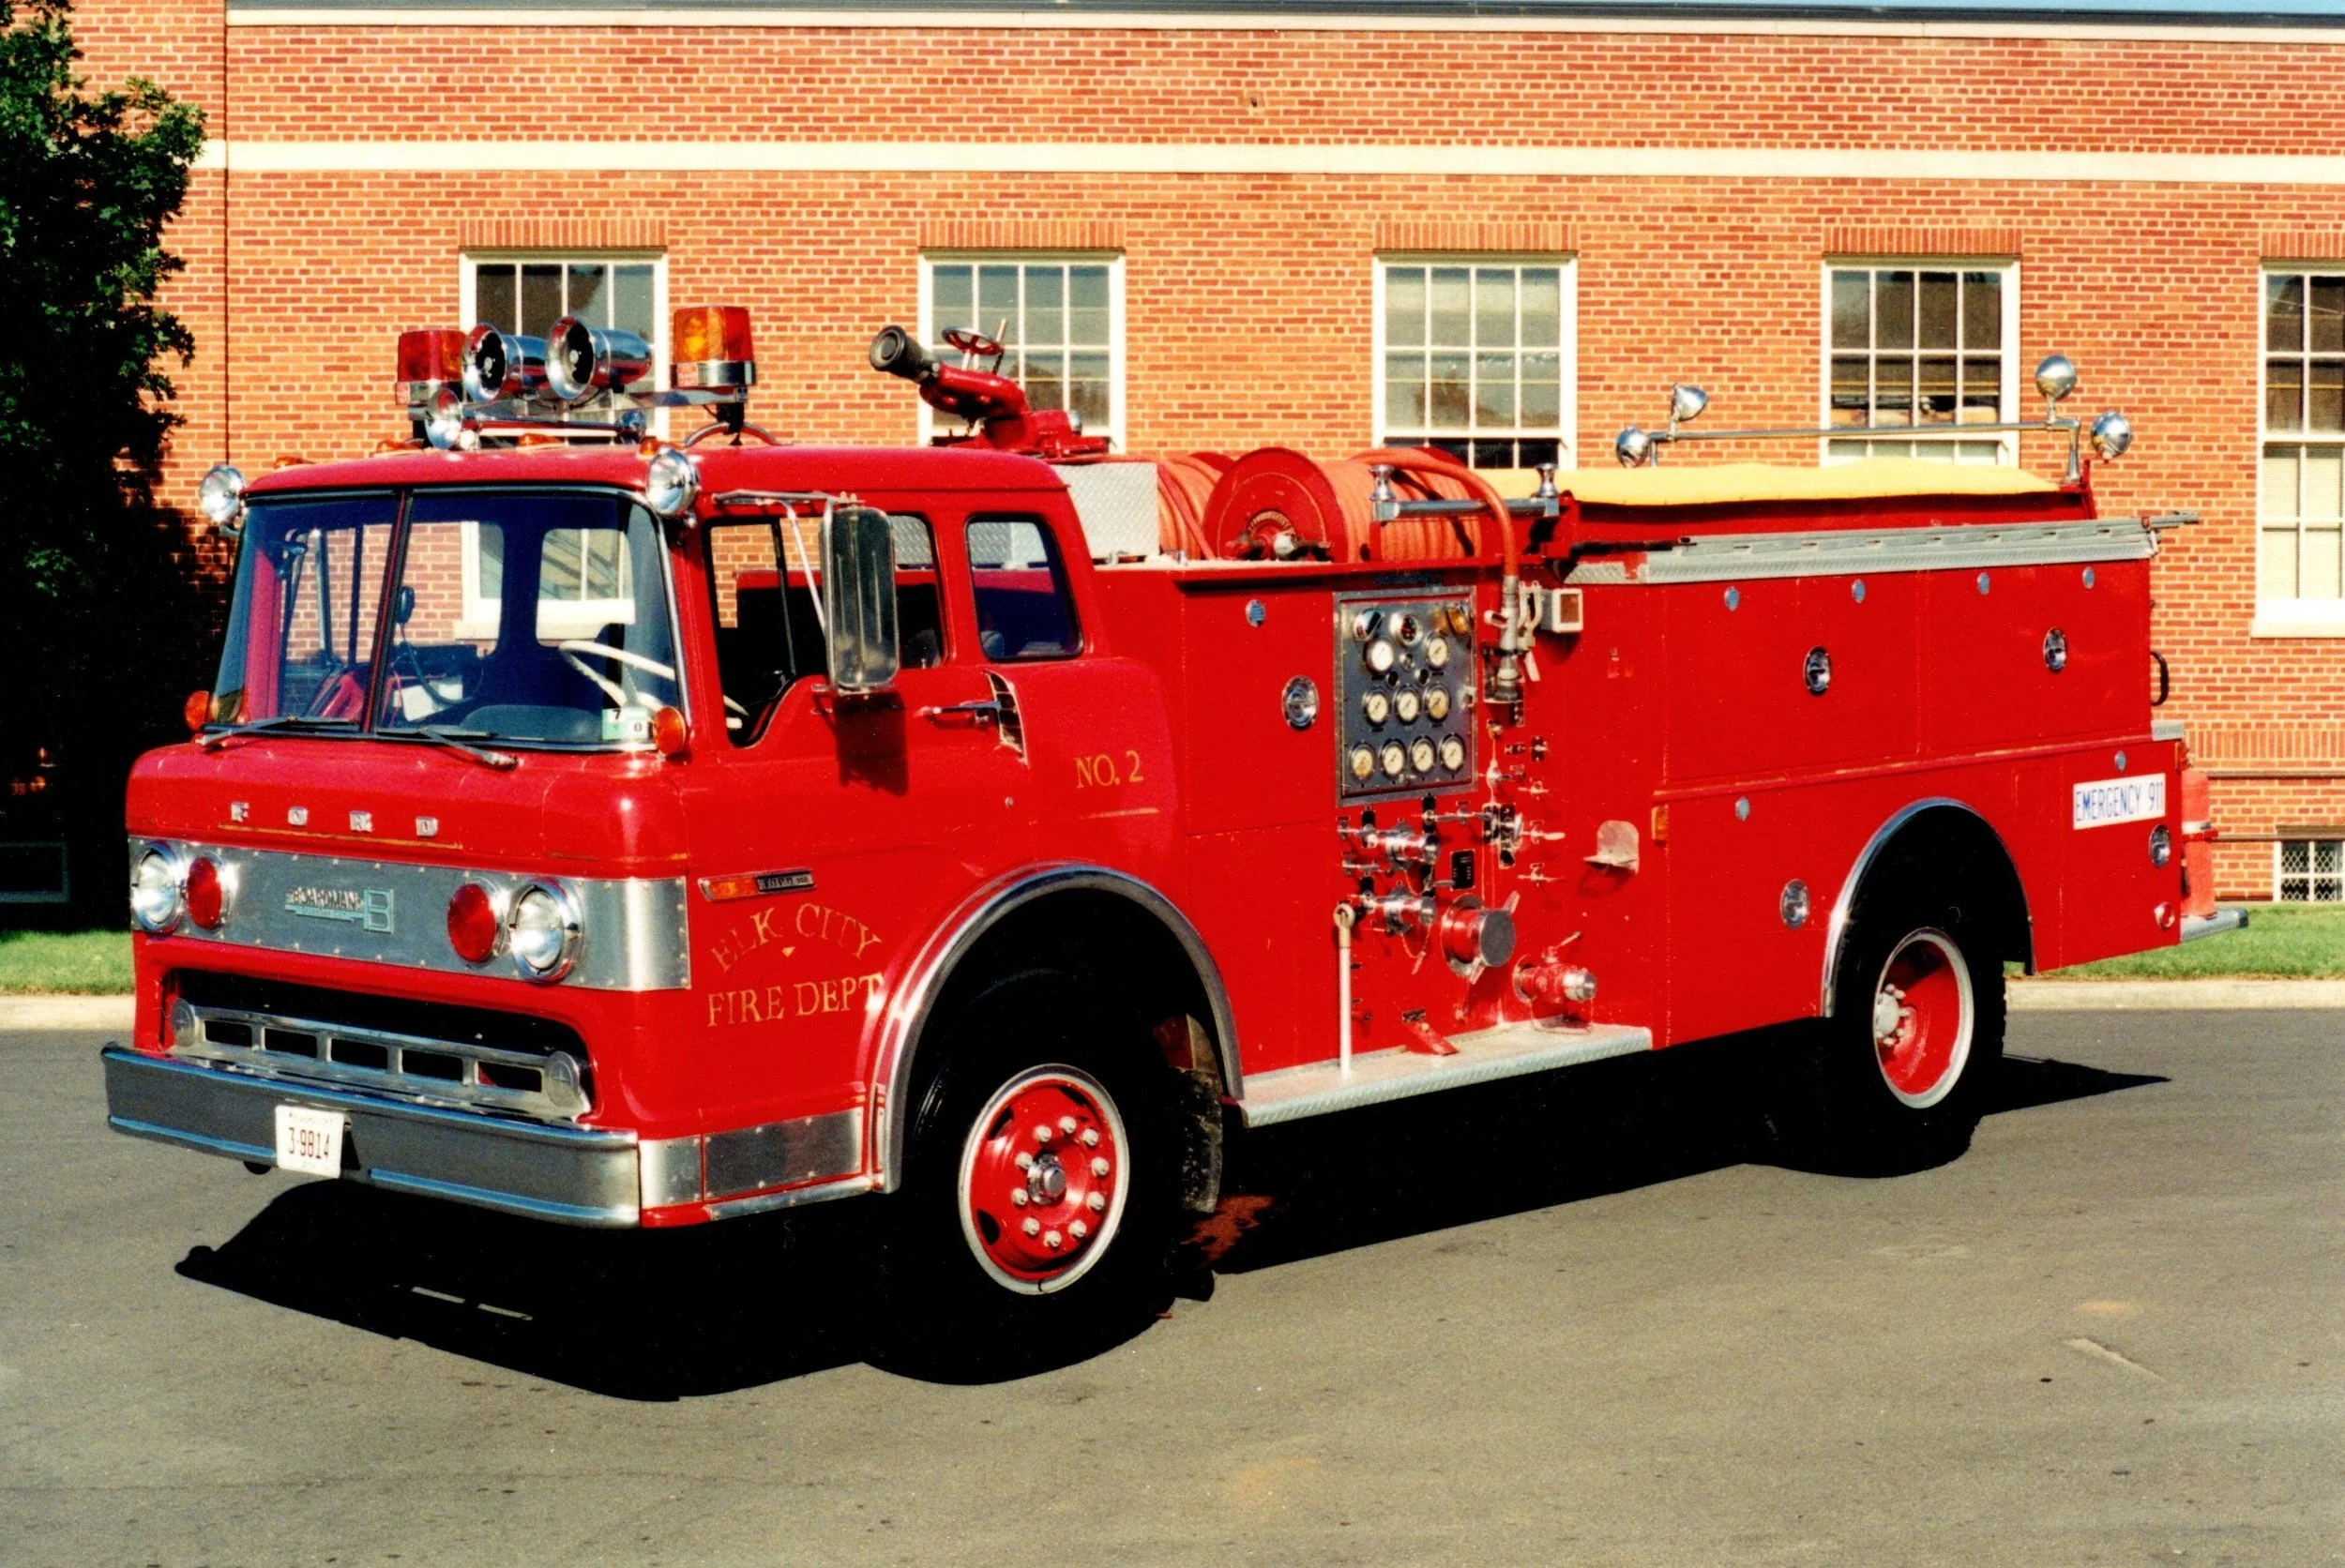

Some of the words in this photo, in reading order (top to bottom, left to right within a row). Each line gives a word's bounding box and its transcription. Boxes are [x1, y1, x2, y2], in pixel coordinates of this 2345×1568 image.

[612, 708, 622, 721] 7
[1073, 754, 1121, 789] NO.
[1126, 749, 1143, 782] 2
[231, 802, 439, 837] FORD
[2076, 784, 2141, 822] EMERGENCY
[2149, 781, 2164, 811] 911
[292, 887, 359, 912] BOARDMAN
[711, 907, 783, 972] ELK
[795, 902, 882, 961] CITY
[707, 986, 785, 1027] FIRE
[794, 972, 885, 1016] DEPT
